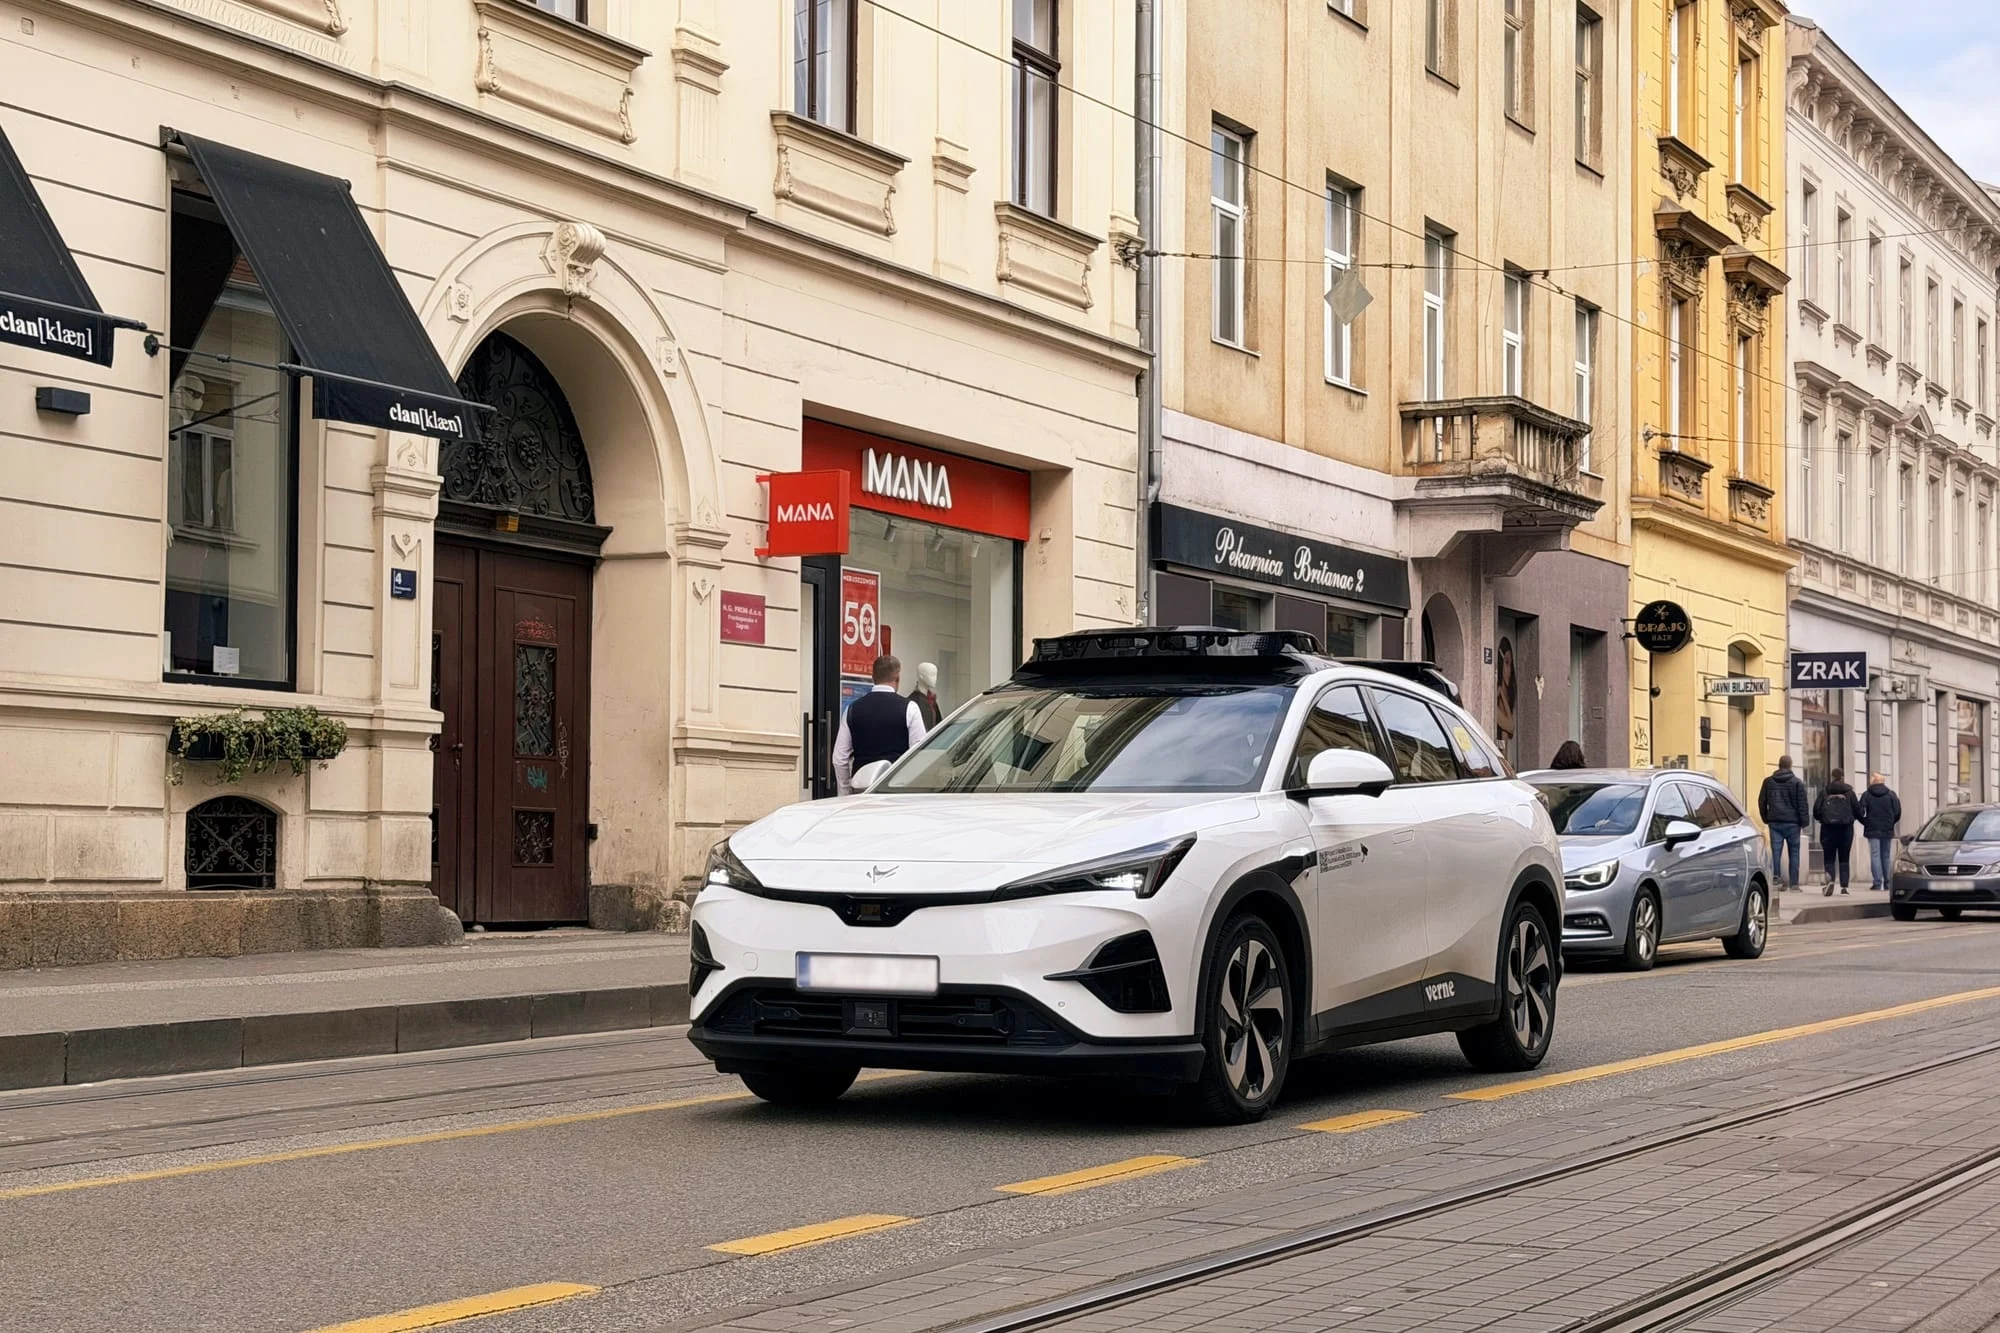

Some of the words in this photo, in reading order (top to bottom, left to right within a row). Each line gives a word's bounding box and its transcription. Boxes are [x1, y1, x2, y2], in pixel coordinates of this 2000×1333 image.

[0, 311, 93, 355] clan[klæn]
[389, 403, 463, 438] clan[klæn]
[865, 447, 952, 509] MANA
[777, 502, 834, 523] MANA
[1214, 527, 1284, 577] Pekarnica
[1293, 546, 1354, 591] Britanac
[1355, 568, 1365, 593] 2
[395, 572, 402, 585] 4
[843, 600, 876, 647] 50
[1637, 622, 1686, 633] BRAJO
[1797, 661, 1860, 680] ZRAK
[1711, 682, 1730, 693] JAVNI
[1425, 980, 1455, 1003] verne
